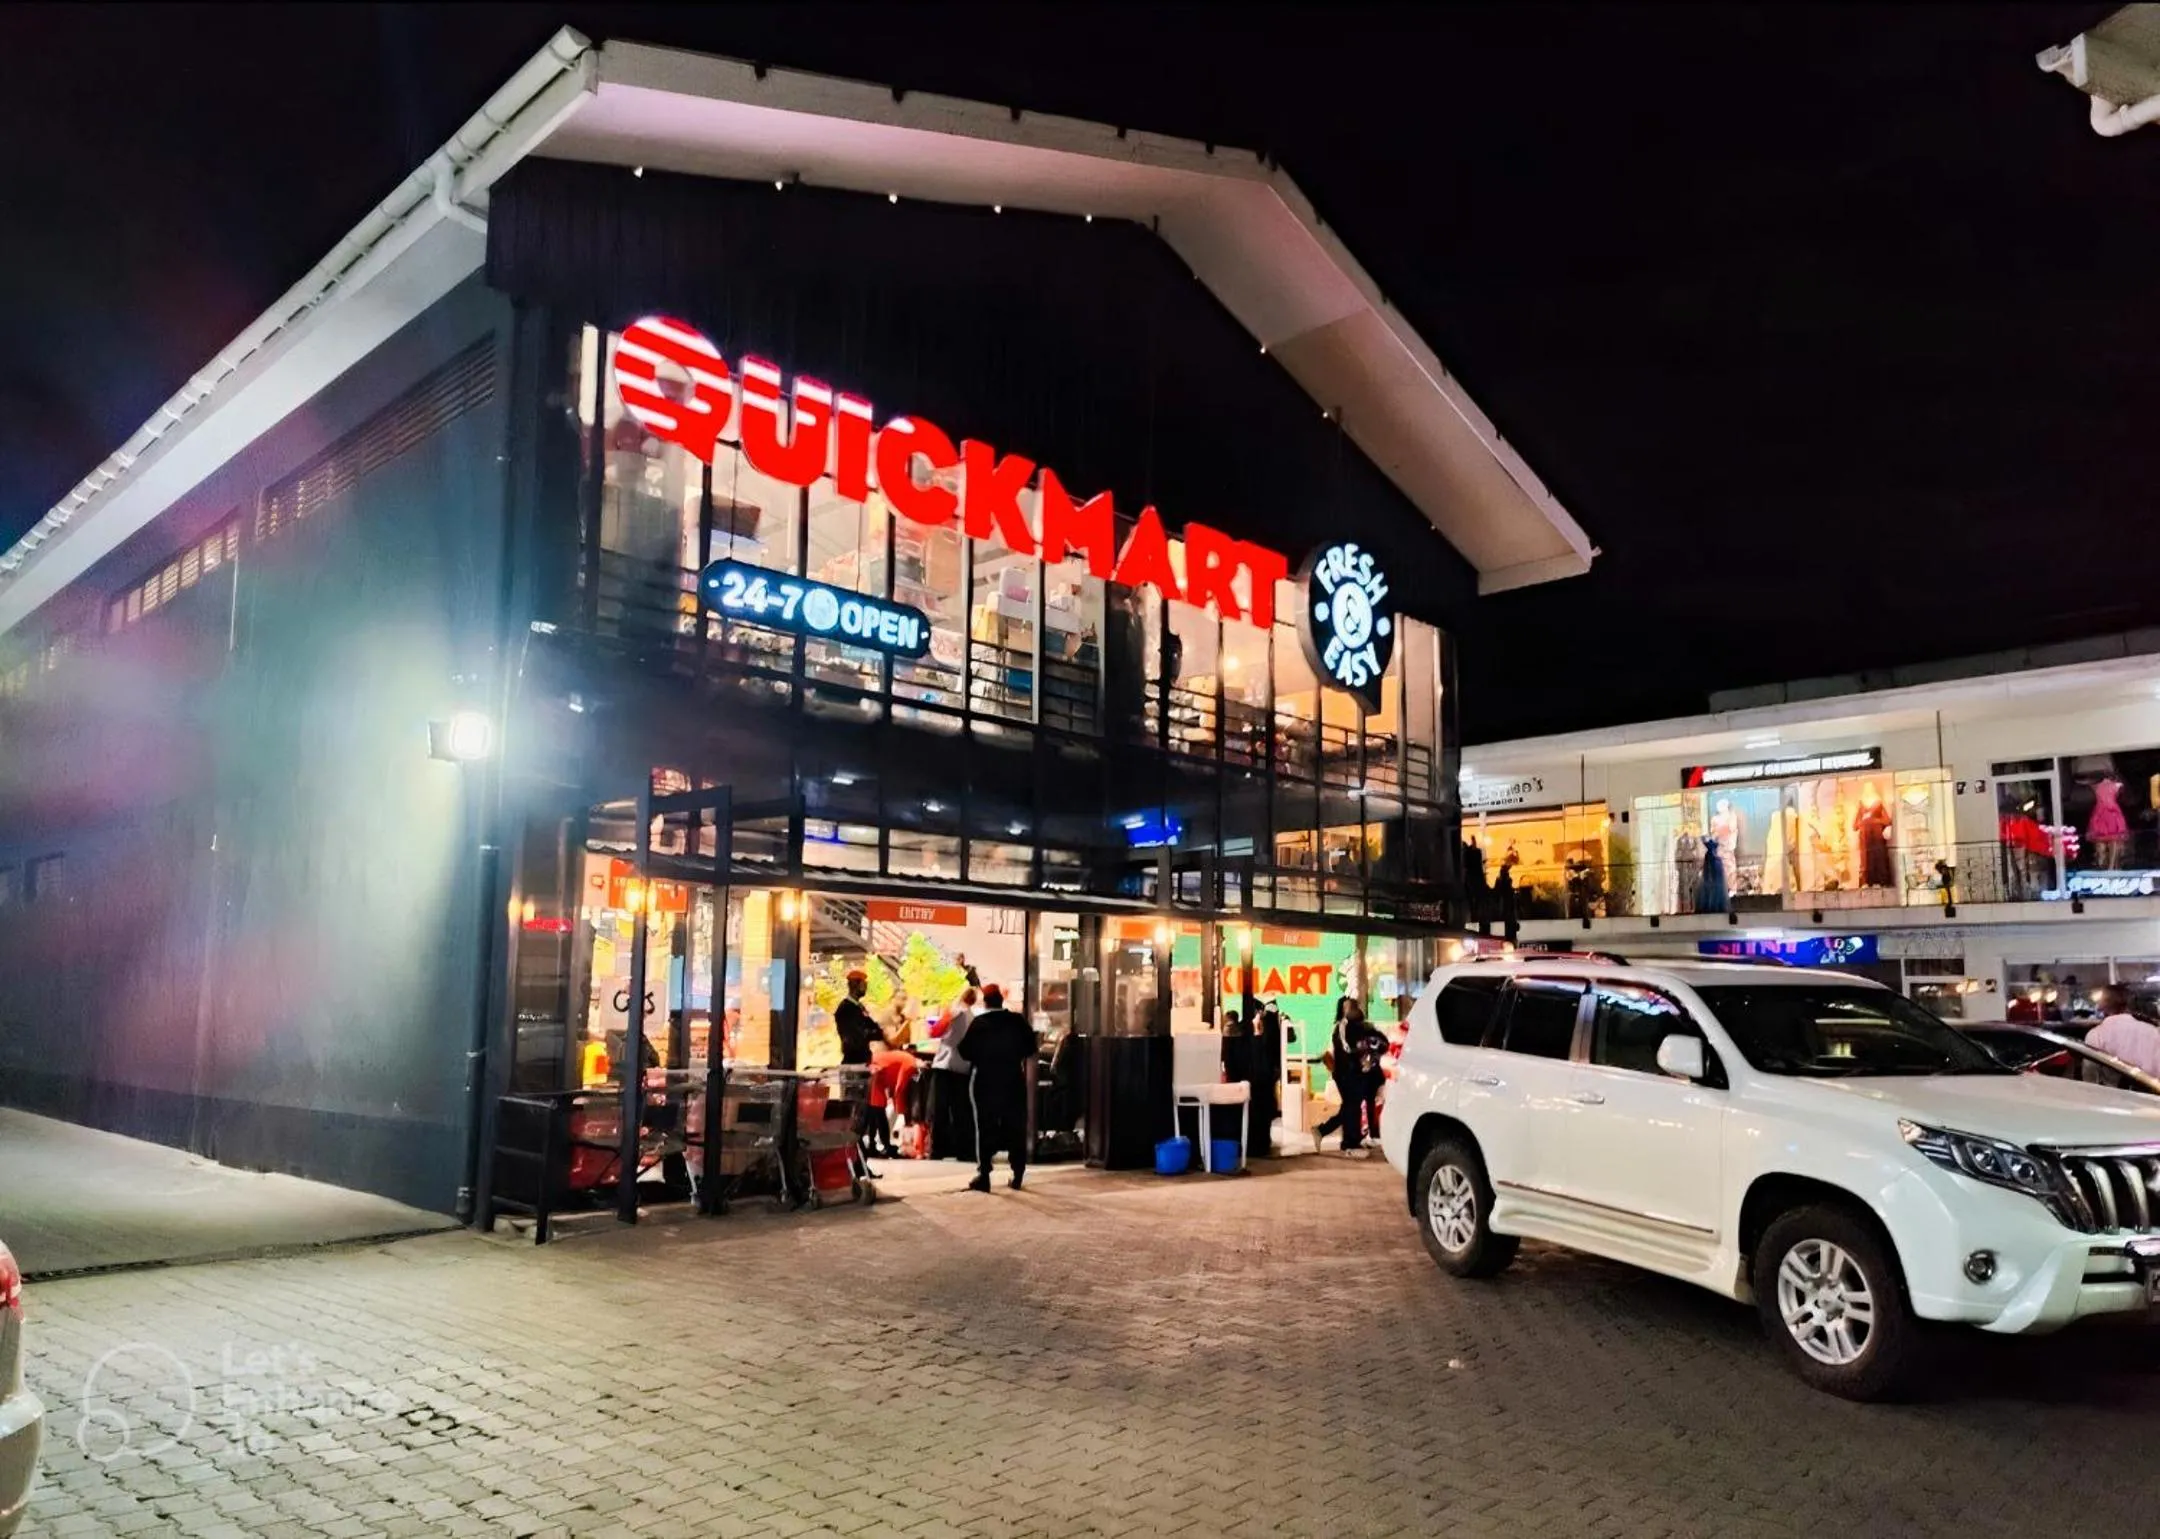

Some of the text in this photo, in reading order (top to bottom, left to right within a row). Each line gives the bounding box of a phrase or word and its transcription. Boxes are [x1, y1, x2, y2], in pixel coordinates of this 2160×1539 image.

[615, 315, 1288, 629] QUICKMART
[1315, 543, 1389, 606] FRESH
[722, 571, 919, 649] 24-7 OPEN
[1324, 636, 1381, 687] EASY
